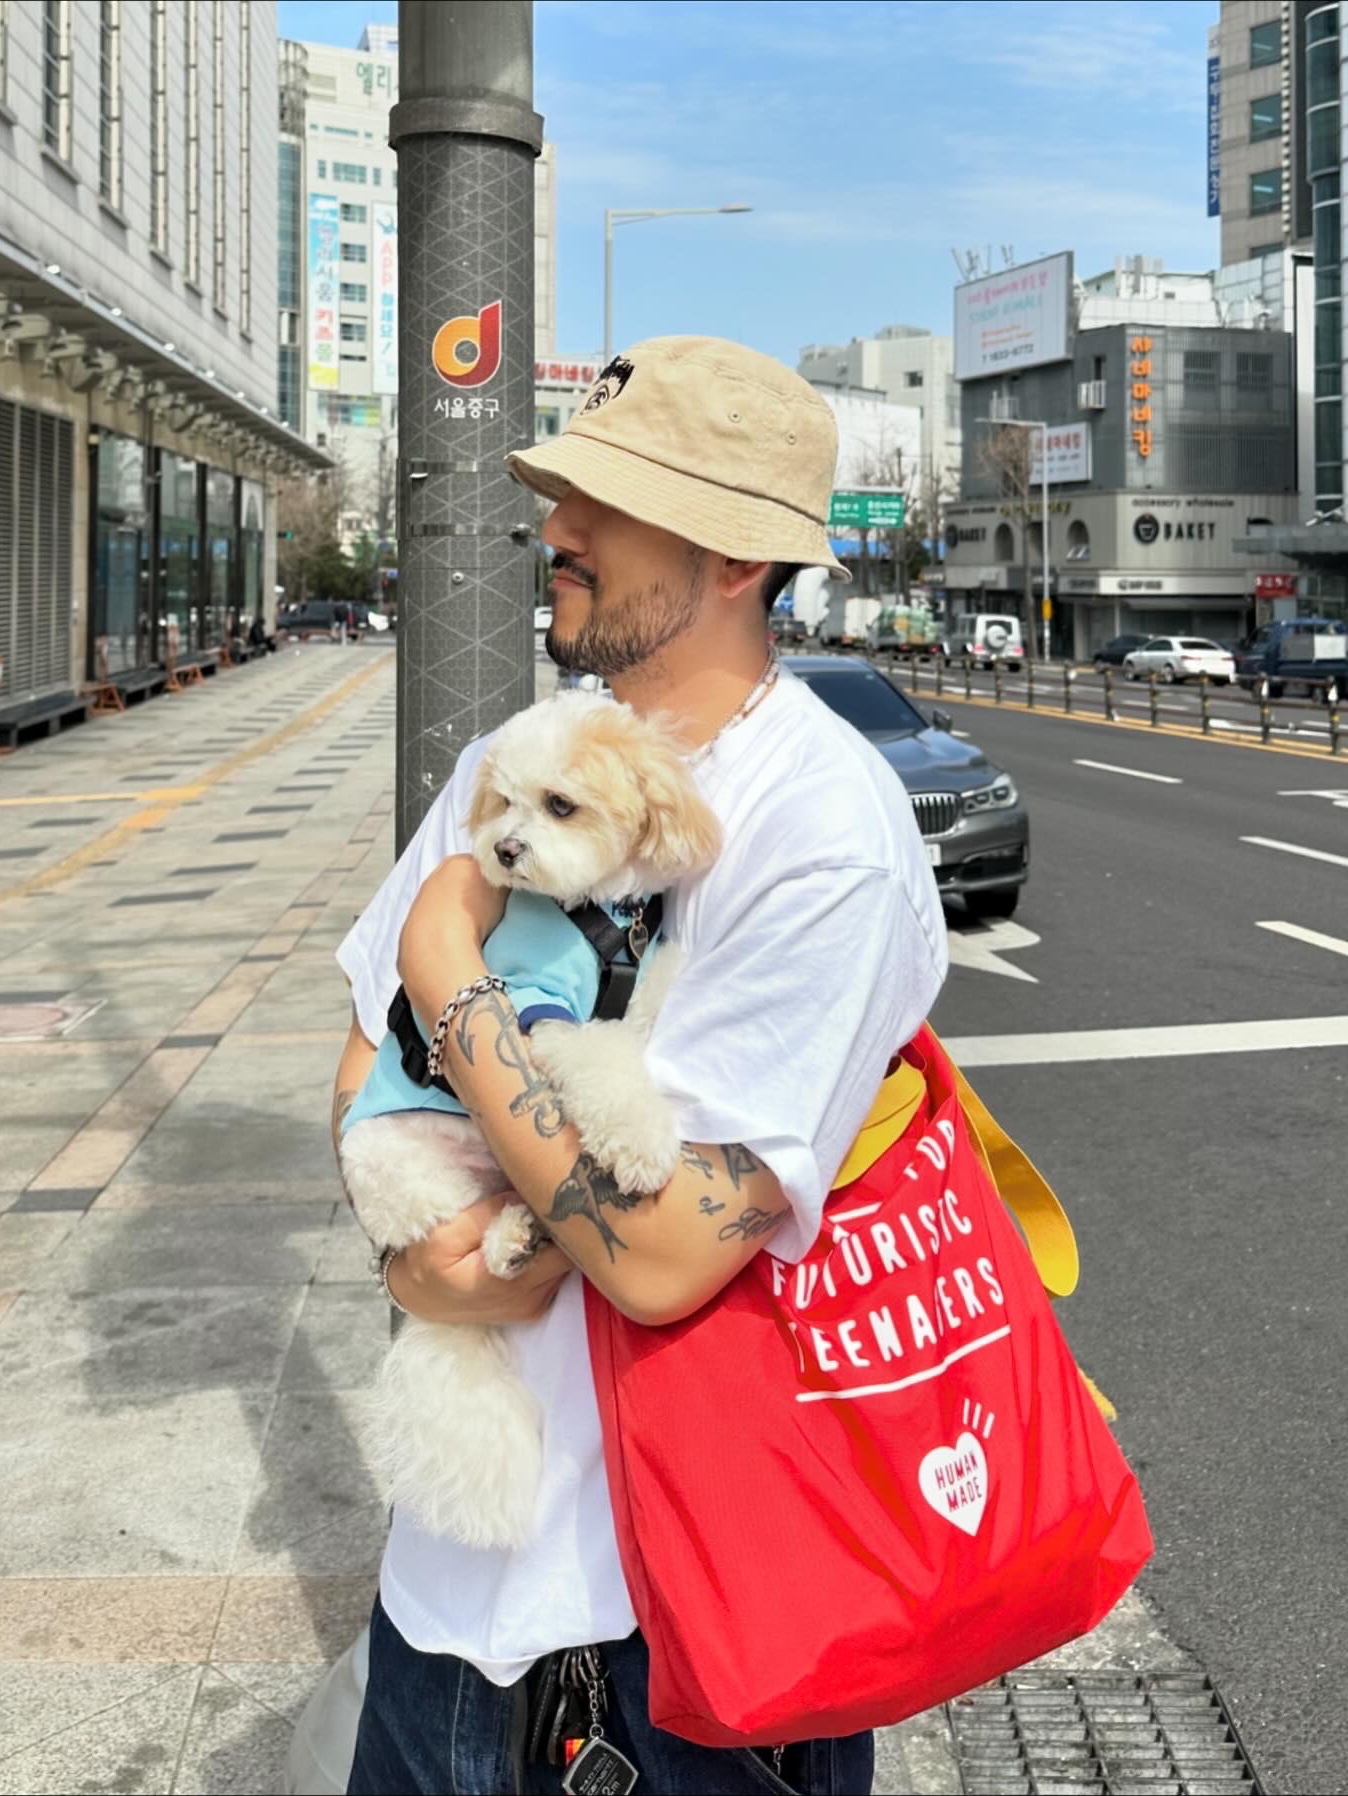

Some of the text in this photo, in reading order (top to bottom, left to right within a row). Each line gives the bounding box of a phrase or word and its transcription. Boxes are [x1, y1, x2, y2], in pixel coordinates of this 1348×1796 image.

[434, 397, 500, 419] 서울중구
[1164, 522, 1215, 541] BAKET
[934, 1450, 979, 1490] HUMAN
[945, 1476, 983, 1513] MADE
